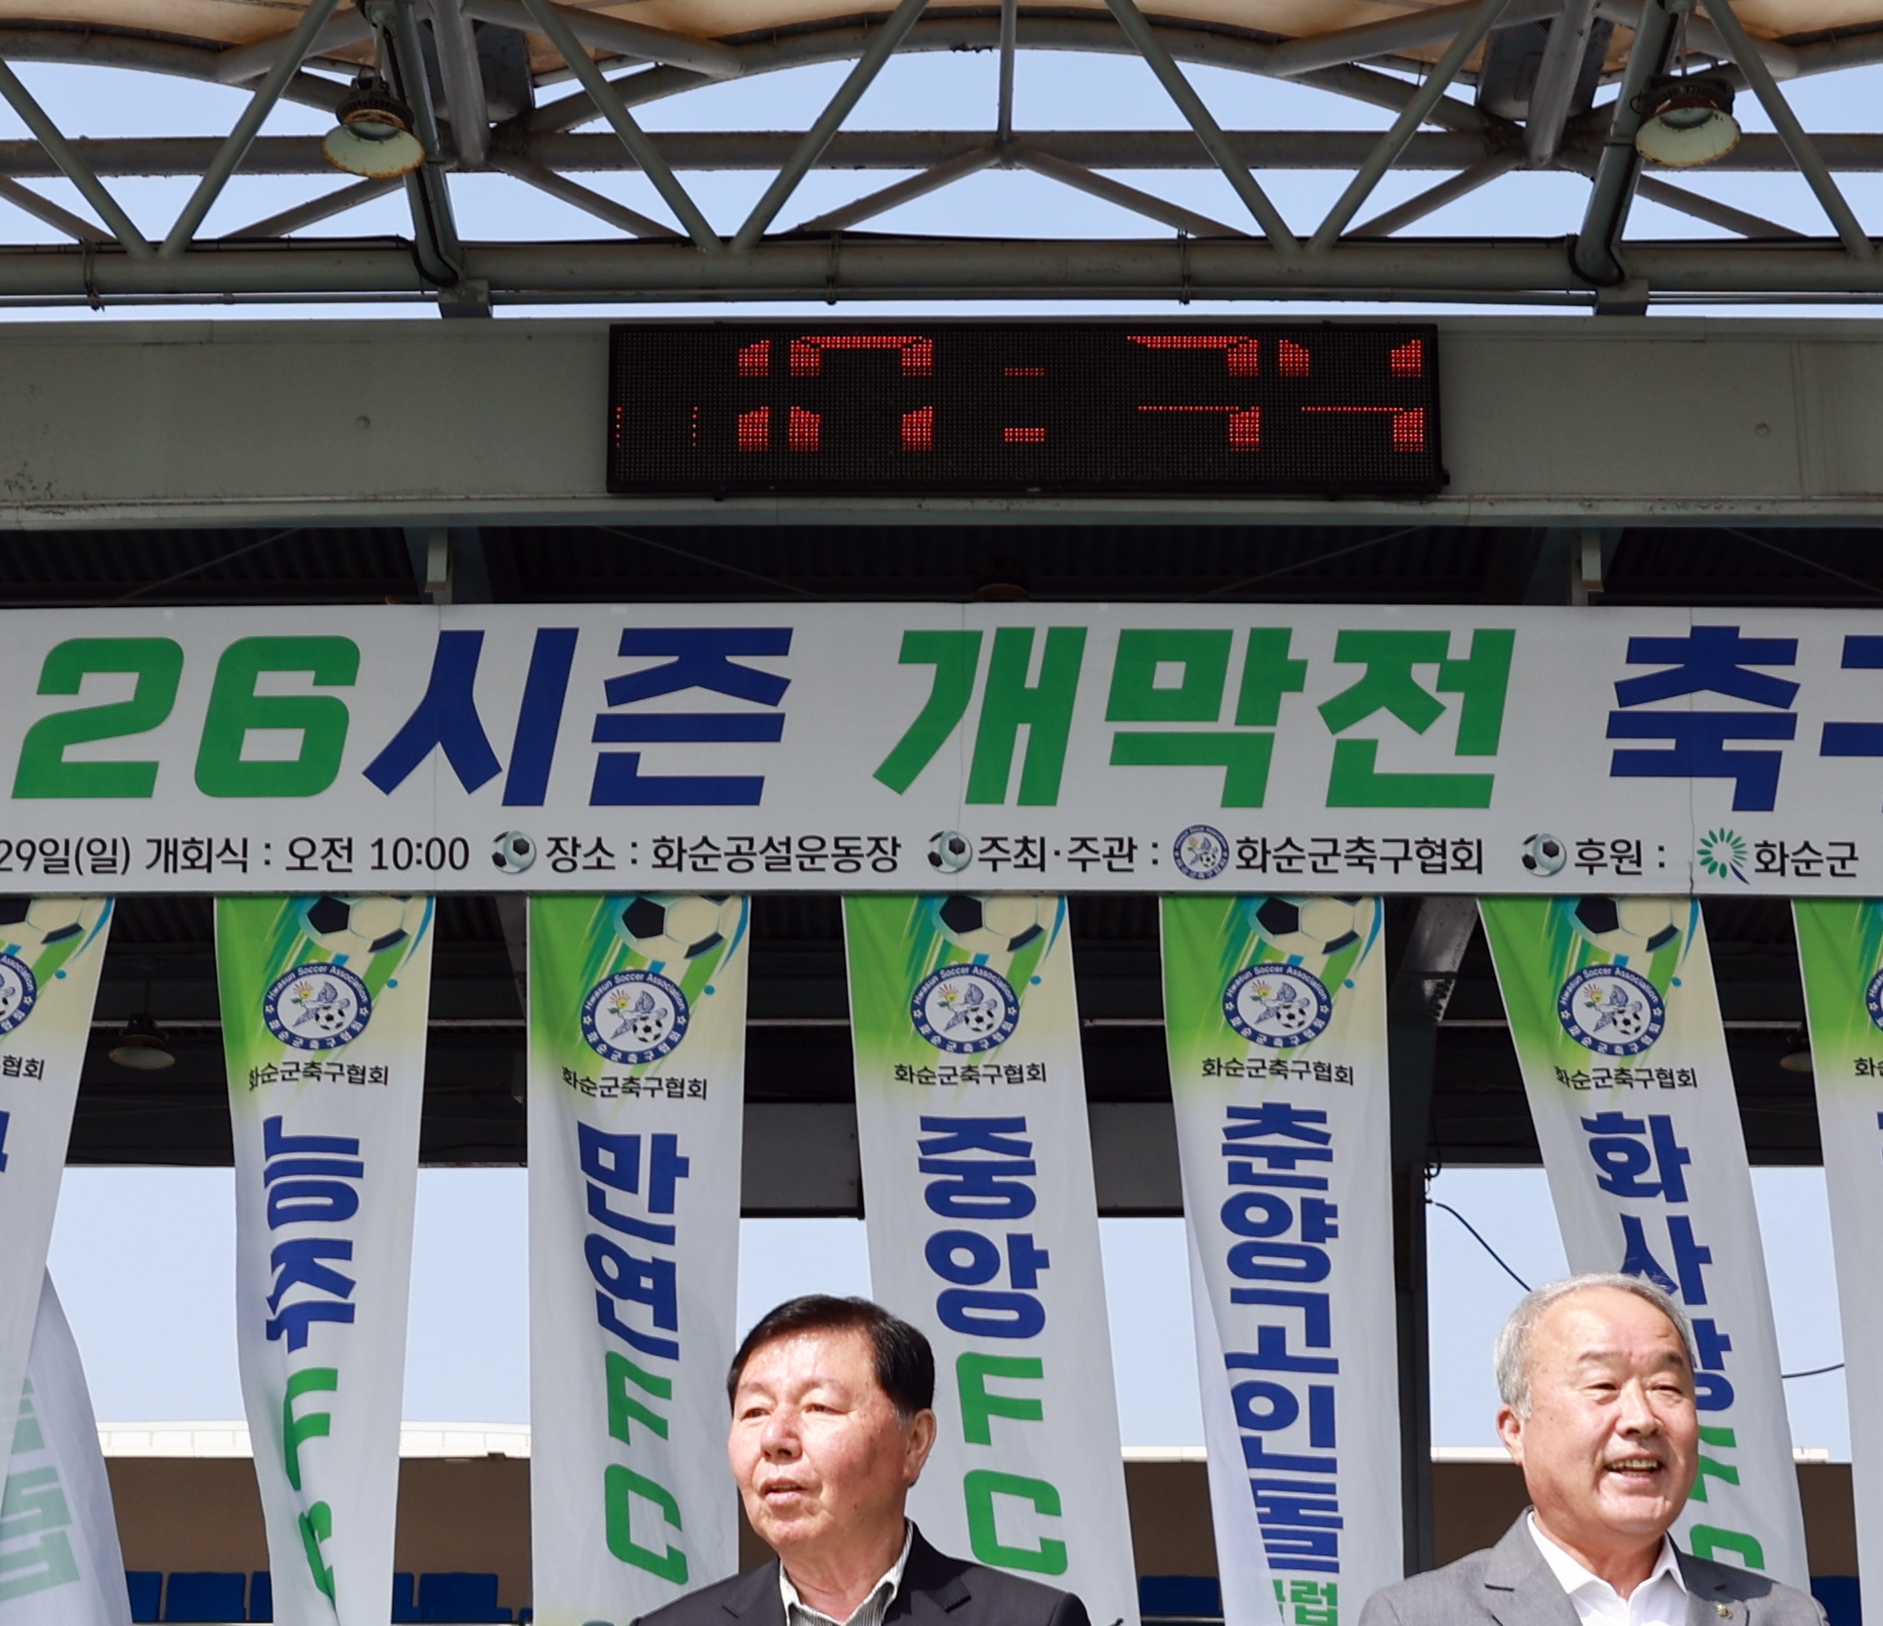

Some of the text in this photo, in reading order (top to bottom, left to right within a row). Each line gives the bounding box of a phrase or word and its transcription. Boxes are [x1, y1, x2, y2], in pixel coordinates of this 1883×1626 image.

[872, 626, 1517, 809] 개막전
[146, 836, 249, 875] 개회식
[285, 837, 355, 874] 오전
[370, 838, 470, 872] 10:00
[546, 832, 616, 874] 장소
[651, 831, 902, 876] 화순공설운동장
[1235, 832, 1484, 877] 화순군축구협회
[1574, 836, 1644, 877] 후원
[1754, 839, 1860, 881] 화순군
[249, 1060, 389, 1092] 화순군축구협회
[562, 1066, 707, 1101] 화순군축구협회
[894, 1062, 1047, 1086] 화순군축구협회
[1201, 1056, 1354, 1087] 화순군축구협회
[1554, 1065, 1698, 1090] 화순군축구협회
